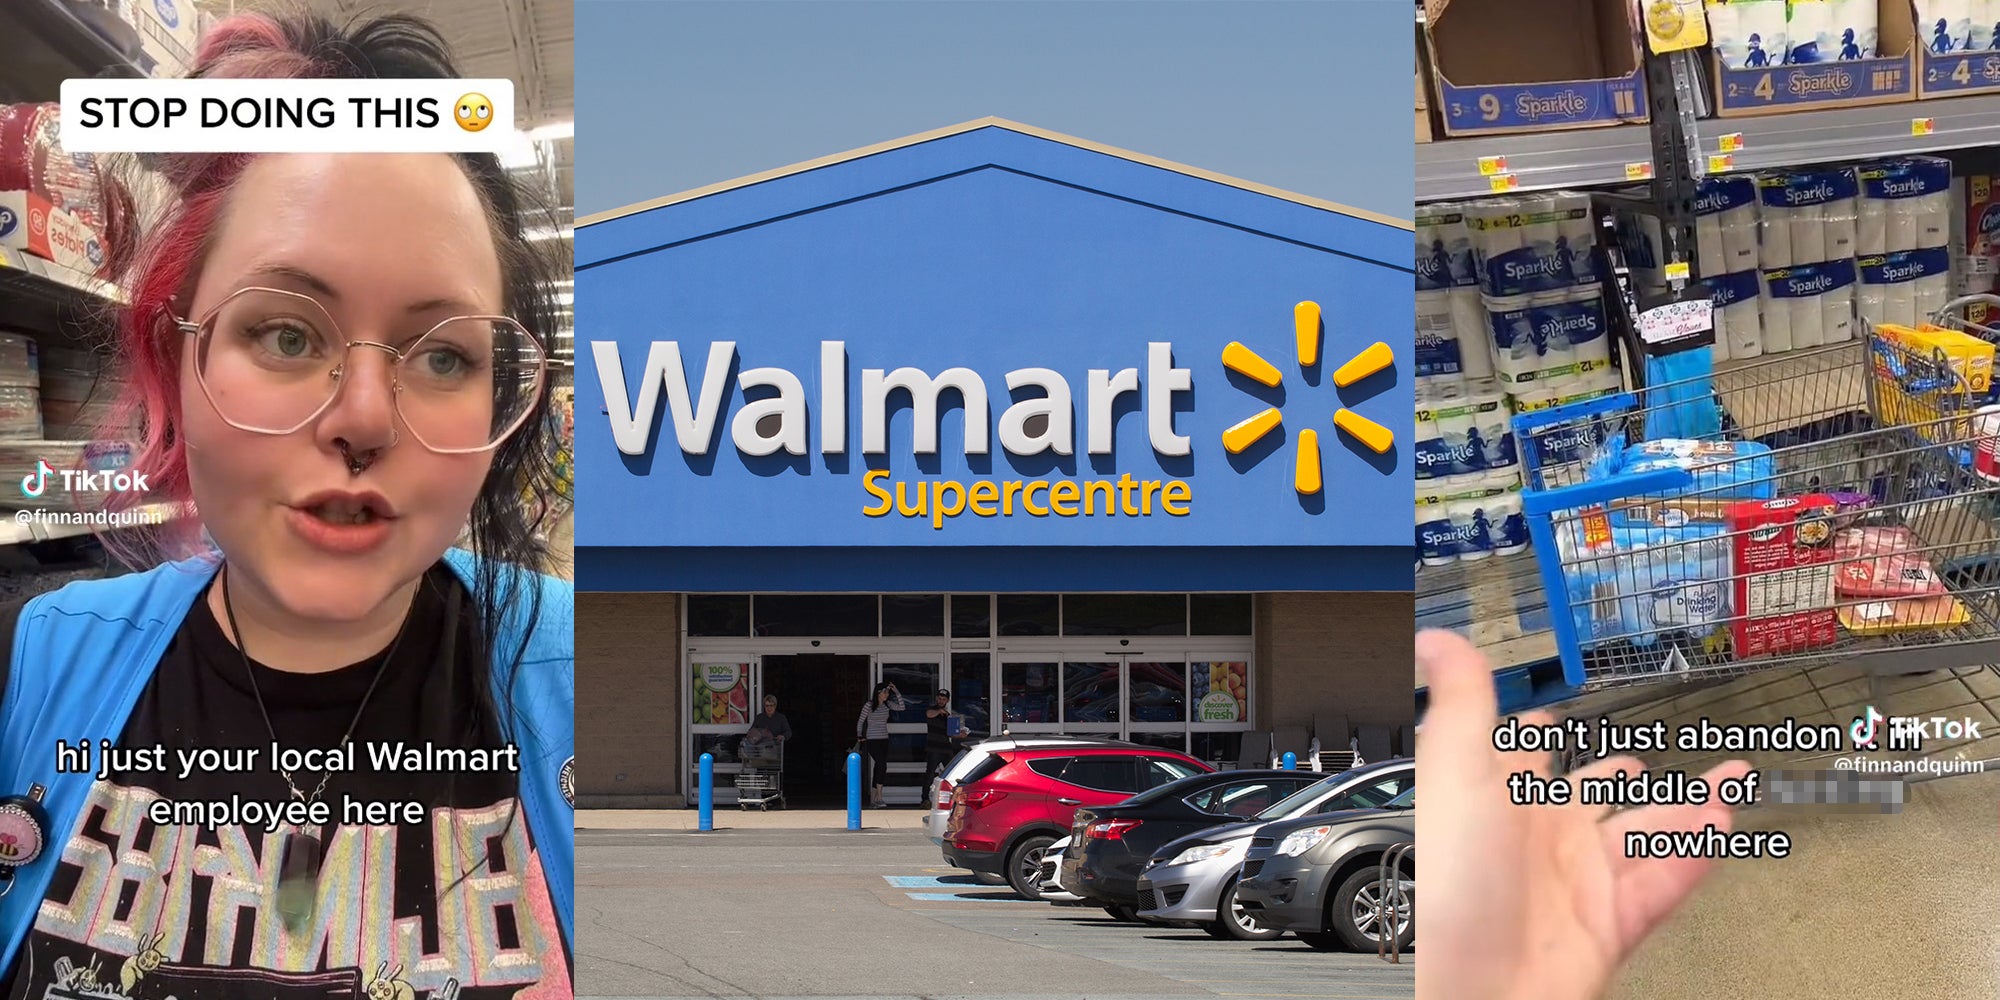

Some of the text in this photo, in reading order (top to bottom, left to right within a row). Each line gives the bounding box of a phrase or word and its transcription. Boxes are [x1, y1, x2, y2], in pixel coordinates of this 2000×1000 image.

[1928, 69, 1937, 82] 2
[1952, 60, 1970, 85] 4
[1728, 68, 1852, 100] 2 4 Sparkle
[1452, 90, 1586, 121] 3 9 Sparkle
[1786, 179, 1834, 204] Sparkle
[1883, 175, 1925, 195] Sparkle
[1506, 215, 1521, 227] 12
[1505, 255, 1563, 279] Sparkle
[1883, 261, 1923, 280] Sparkle
[1789, 274, 1832, 292] Sparkle
[1711, 289, 1734, 303] rkle
[1541, 314, 1596, 337] Sparkle
[1415, 333, 1443, 347] arkle
[591, 341, 1191, 456] Walmart
[1546, 398, 1559, 408] 12
[1416, 410, 1431, 421] 12
[1544, 430, 1598, 452] Sparkle
[1416, 445, 1474, 465] Sparkle
[863, 470, 1192, 529] Supercentre
[1425, 496, 1439, 504] 12
[1423, 525, 1480, 545] Sparkle
[1677, 596, 1716, 605] Dinking
[1689, 604, 1716, 613] Water
[708, 666, 733, 674] 100%
[1204, 709, 1234, 720] fresh
